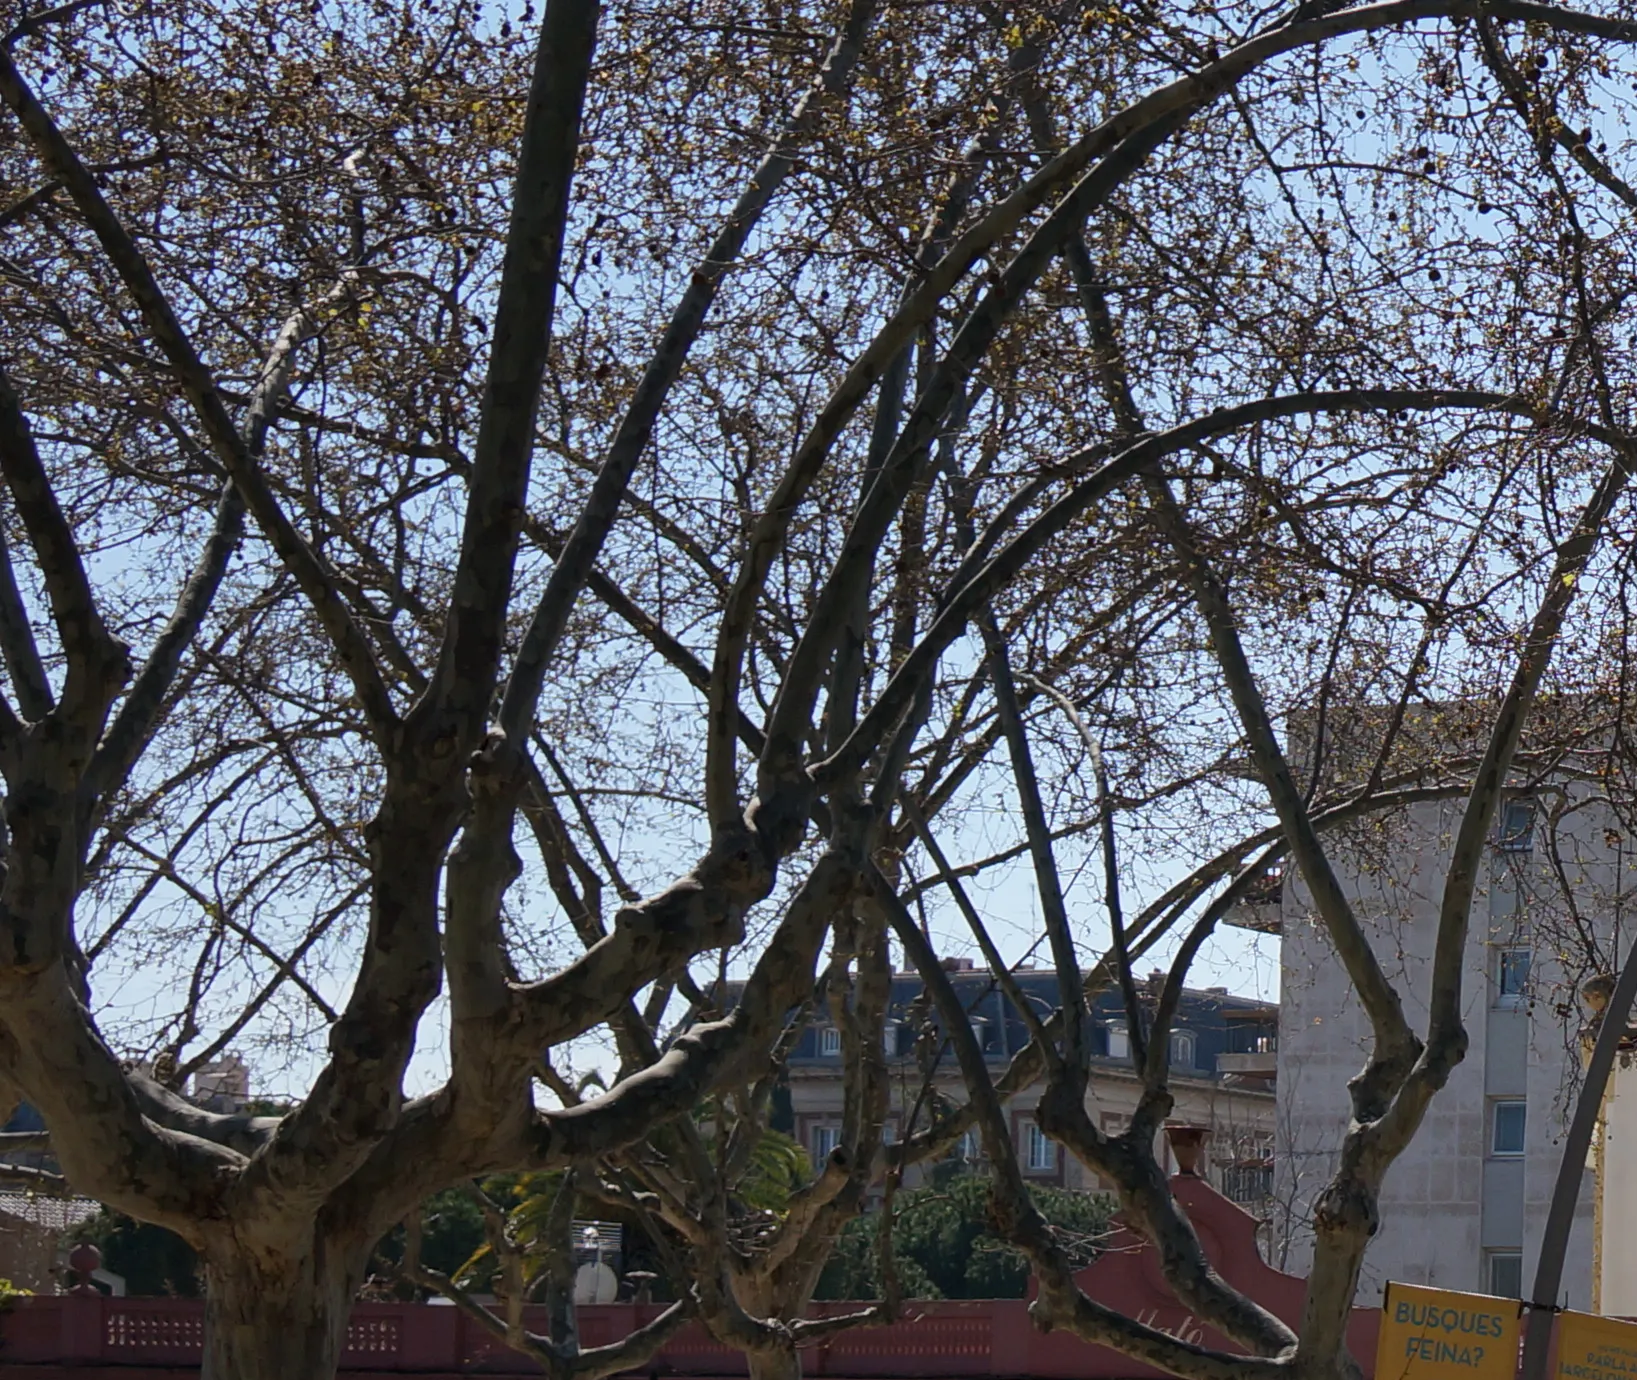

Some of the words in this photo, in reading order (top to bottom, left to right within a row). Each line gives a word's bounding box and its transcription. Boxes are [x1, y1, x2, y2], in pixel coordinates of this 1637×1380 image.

[1395, 1302, 1503, 1338] BUSQUES
[1406, 1338, 1484, 1369] FEINA?
[1587, 1352, 1626, 1370] PARLA
